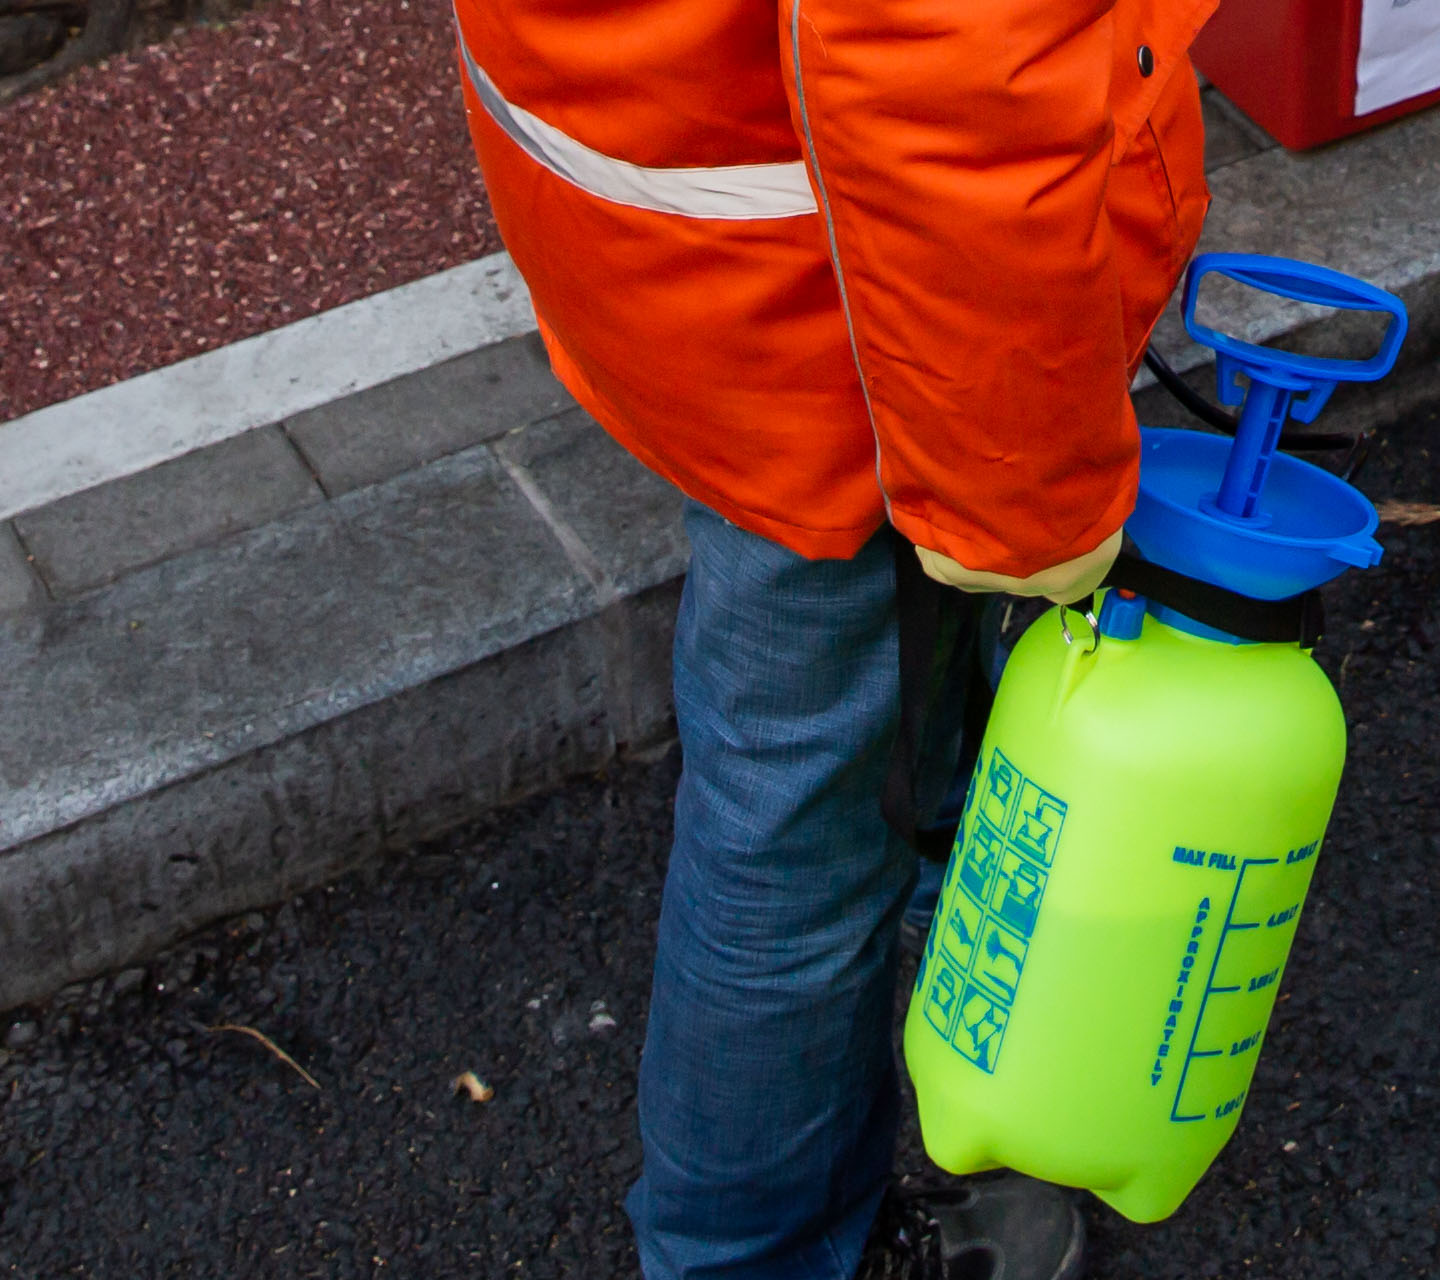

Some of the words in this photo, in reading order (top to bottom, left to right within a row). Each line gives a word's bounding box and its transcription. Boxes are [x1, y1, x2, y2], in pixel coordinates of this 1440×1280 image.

[1172, 846, 1206, 866] MAX
[1207, 853, 1237, 871] FILL
[1151, 897, 1211, 1086] APPROXIMATELY
